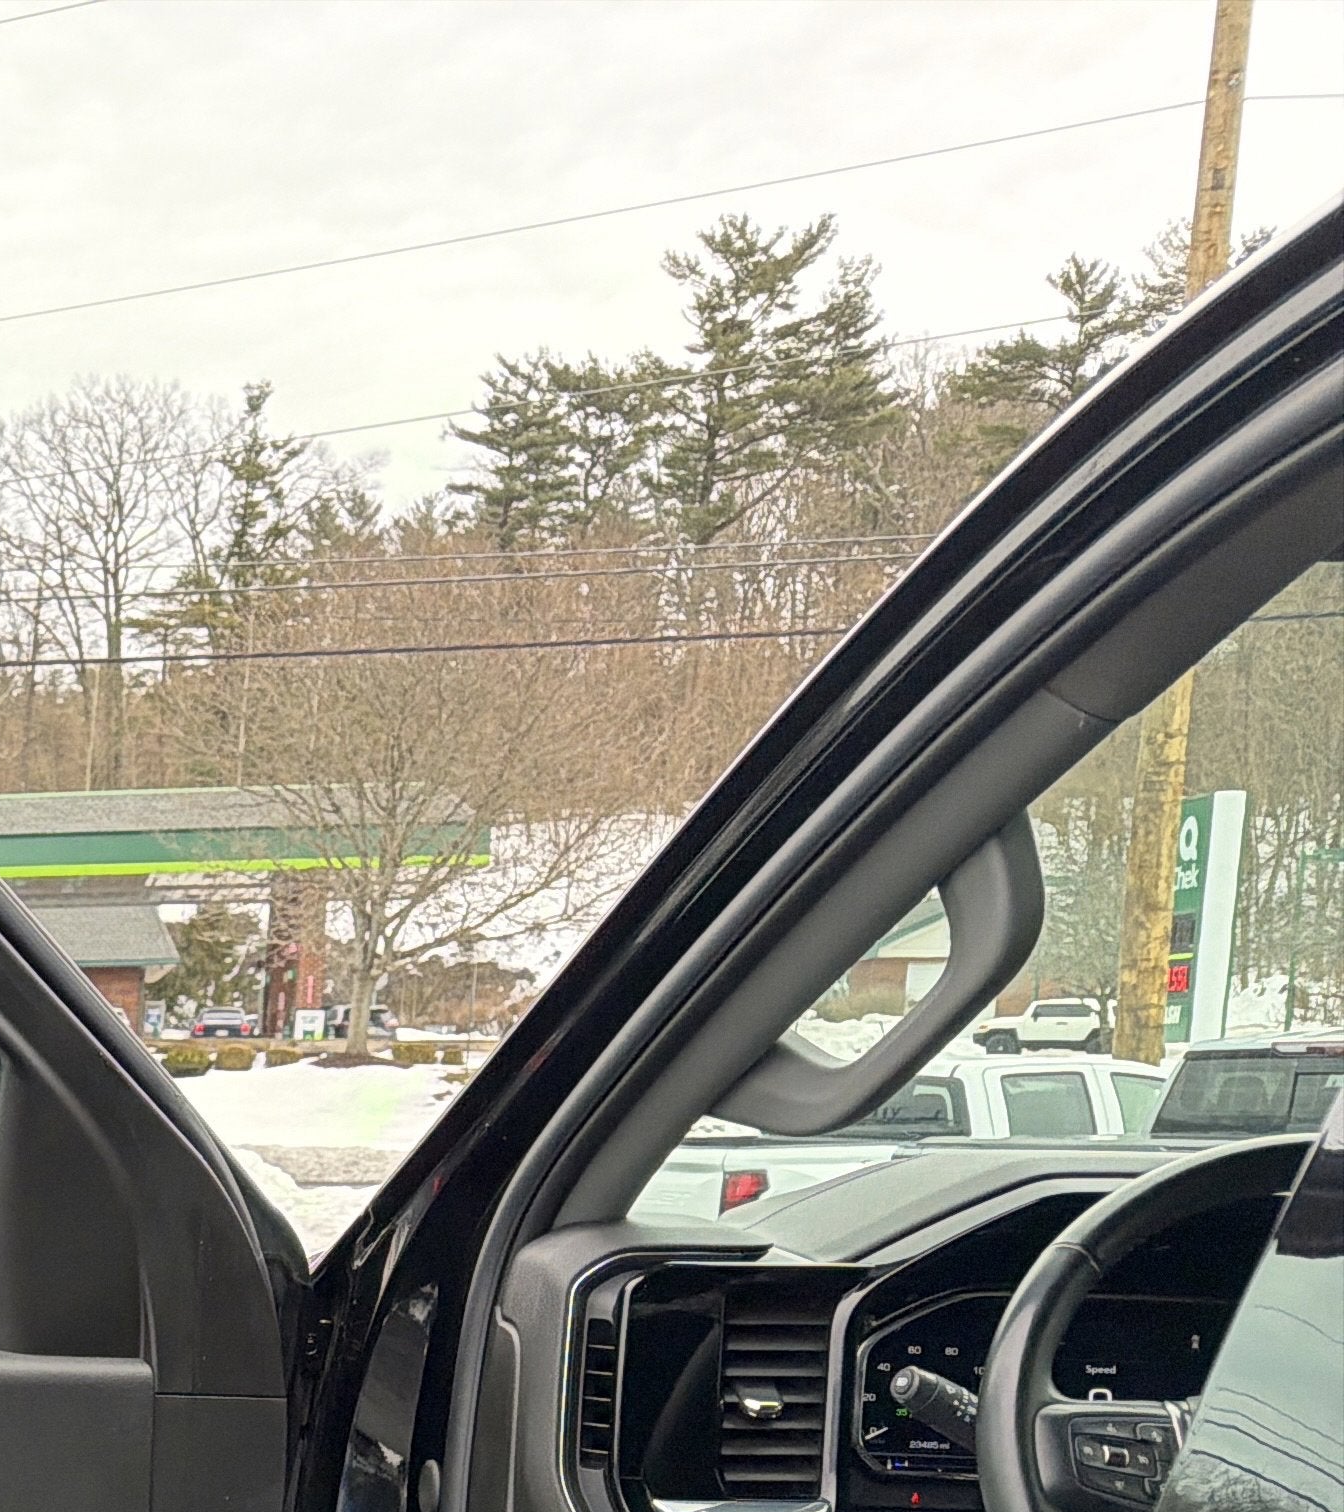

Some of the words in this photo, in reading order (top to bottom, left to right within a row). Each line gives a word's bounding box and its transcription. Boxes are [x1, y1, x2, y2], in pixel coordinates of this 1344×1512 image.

[907, 1346, 922, 1355] 60
[945, 1347, 959, 1356] 80
[877, 1363, 891, 1372] 40
[1085, 1364, 1117, 1376] Speed
